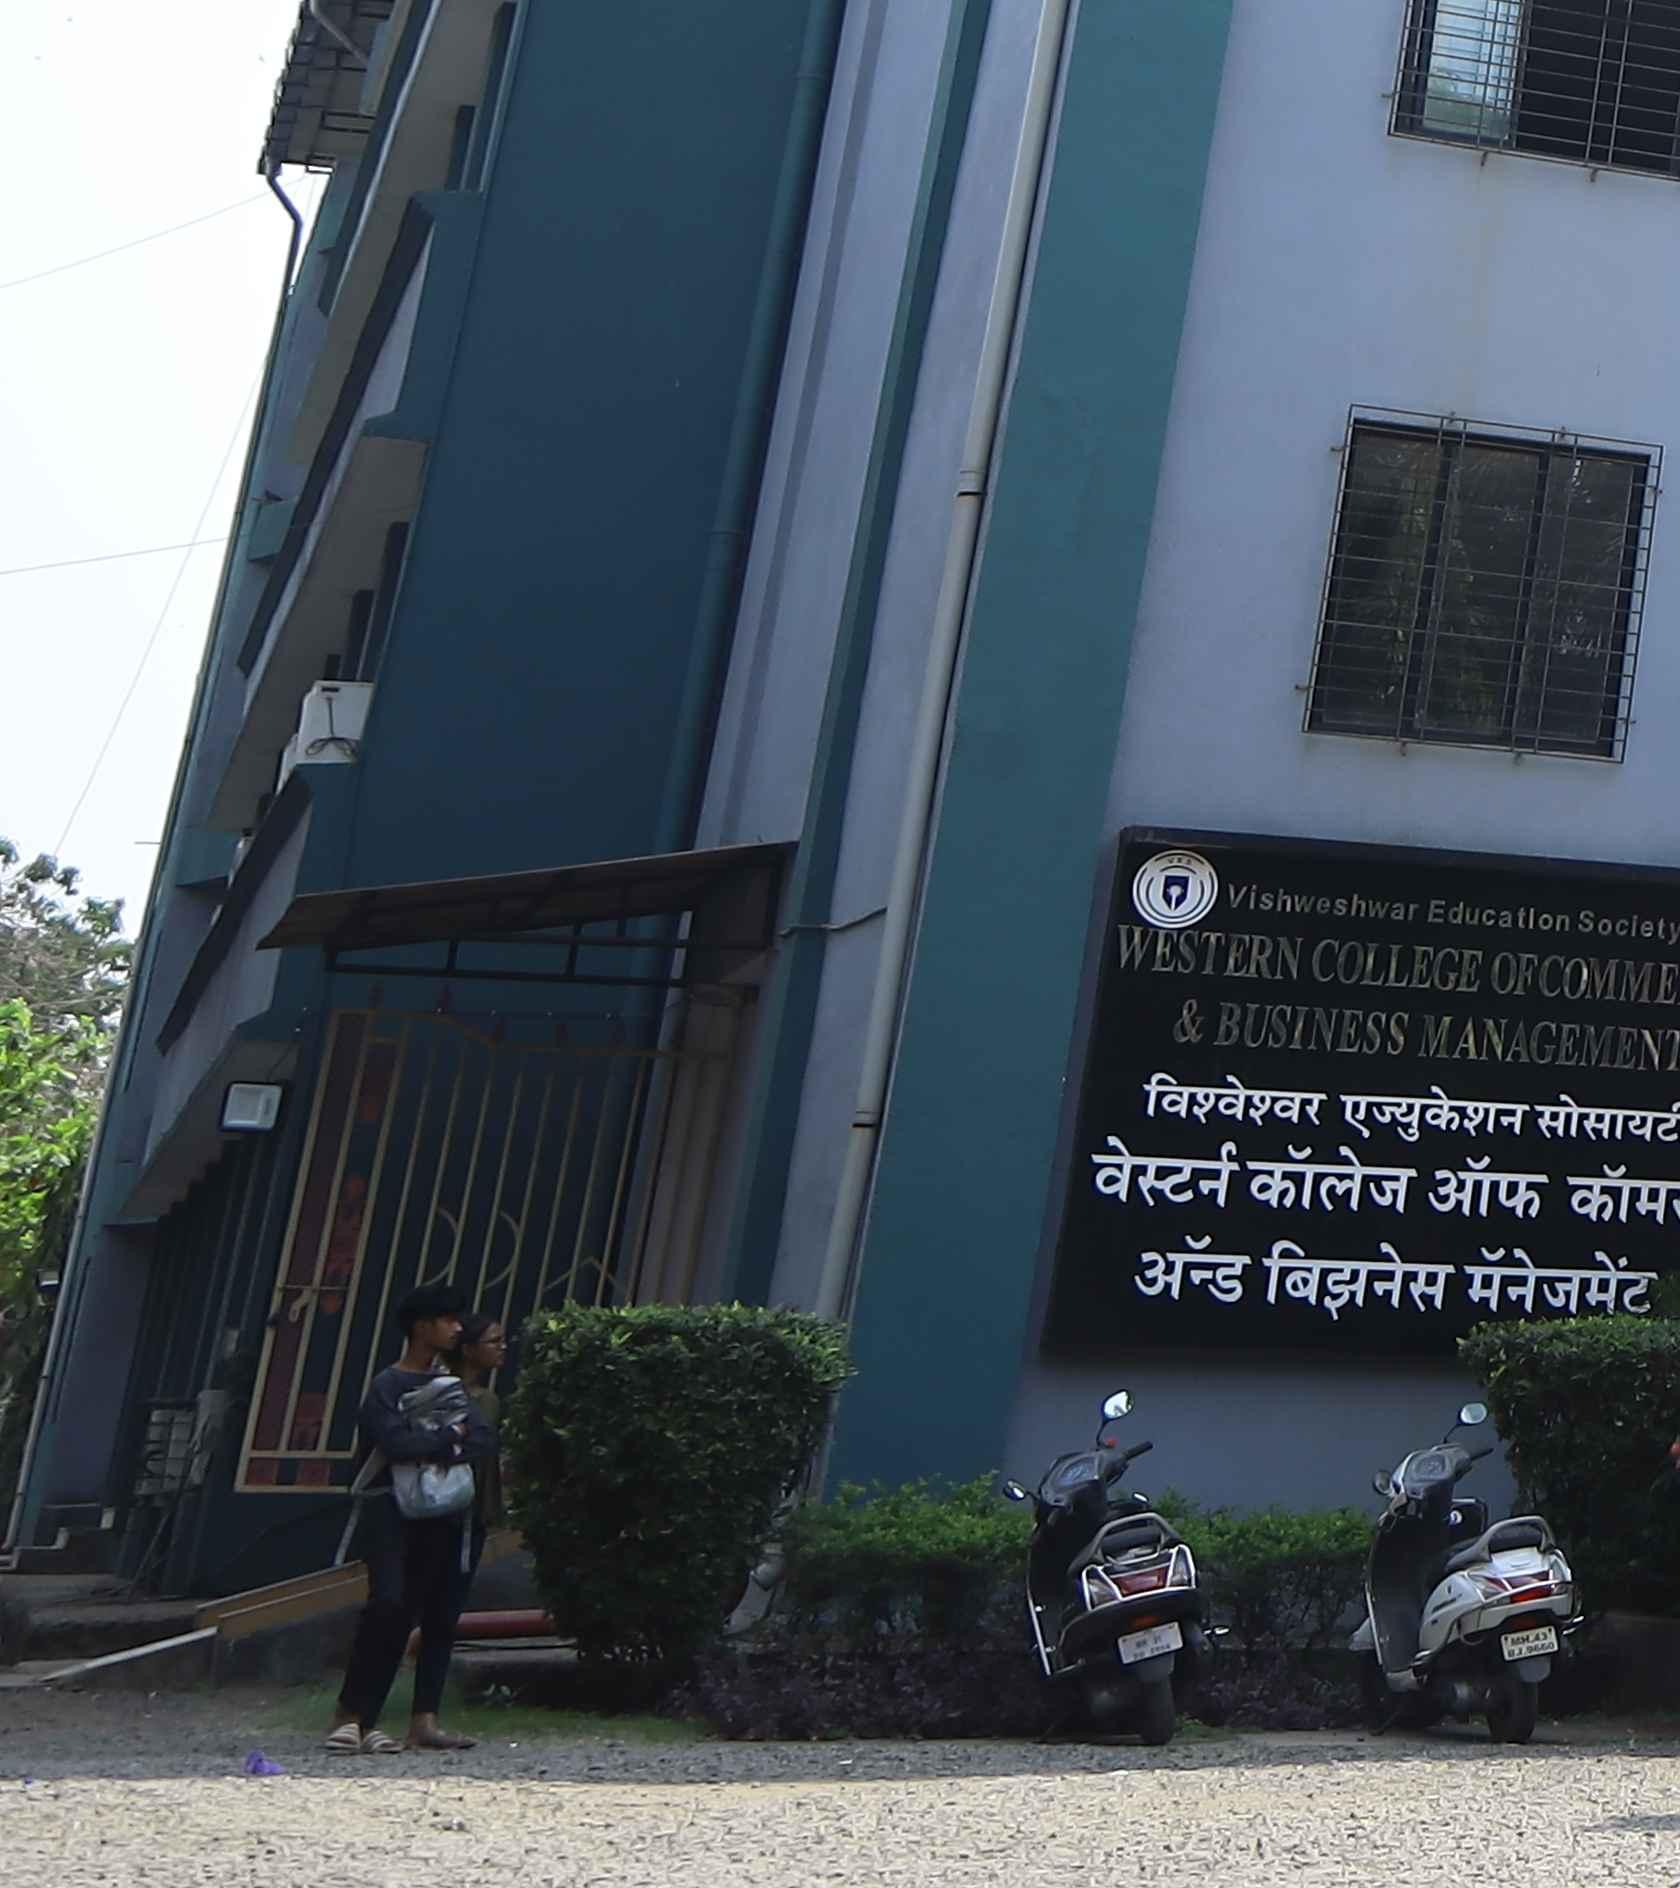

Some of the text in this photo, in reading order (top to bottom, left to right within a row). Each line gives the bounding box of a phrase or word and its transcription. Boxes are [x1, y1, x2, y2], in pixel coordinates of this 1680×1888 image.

[1227, 884, 1419, 922] Vishweshwar
[1427, 899, 1571, 932] Education
[1117, 924, 1304, 981] WESTERN
[1312, 938, 1483, 992] COLLEGE
[1173, 998, 1205, 1044] &
[1214, 1002, 1409, 1056] BUSINESS
[1141, 1072, 1328, 1127] विश्वेश्वर
[1339, 1085, 1530, 1143] एज्युकेशन
[1091, 1135, 1241, 1208] वेस्टर्न
[1245, 1144, 1419, 1215] कॉलेज
[1428, 1155, 1550, 1219] ऑफ
[1262, 1239, 1457, 1321] बिझनेस
